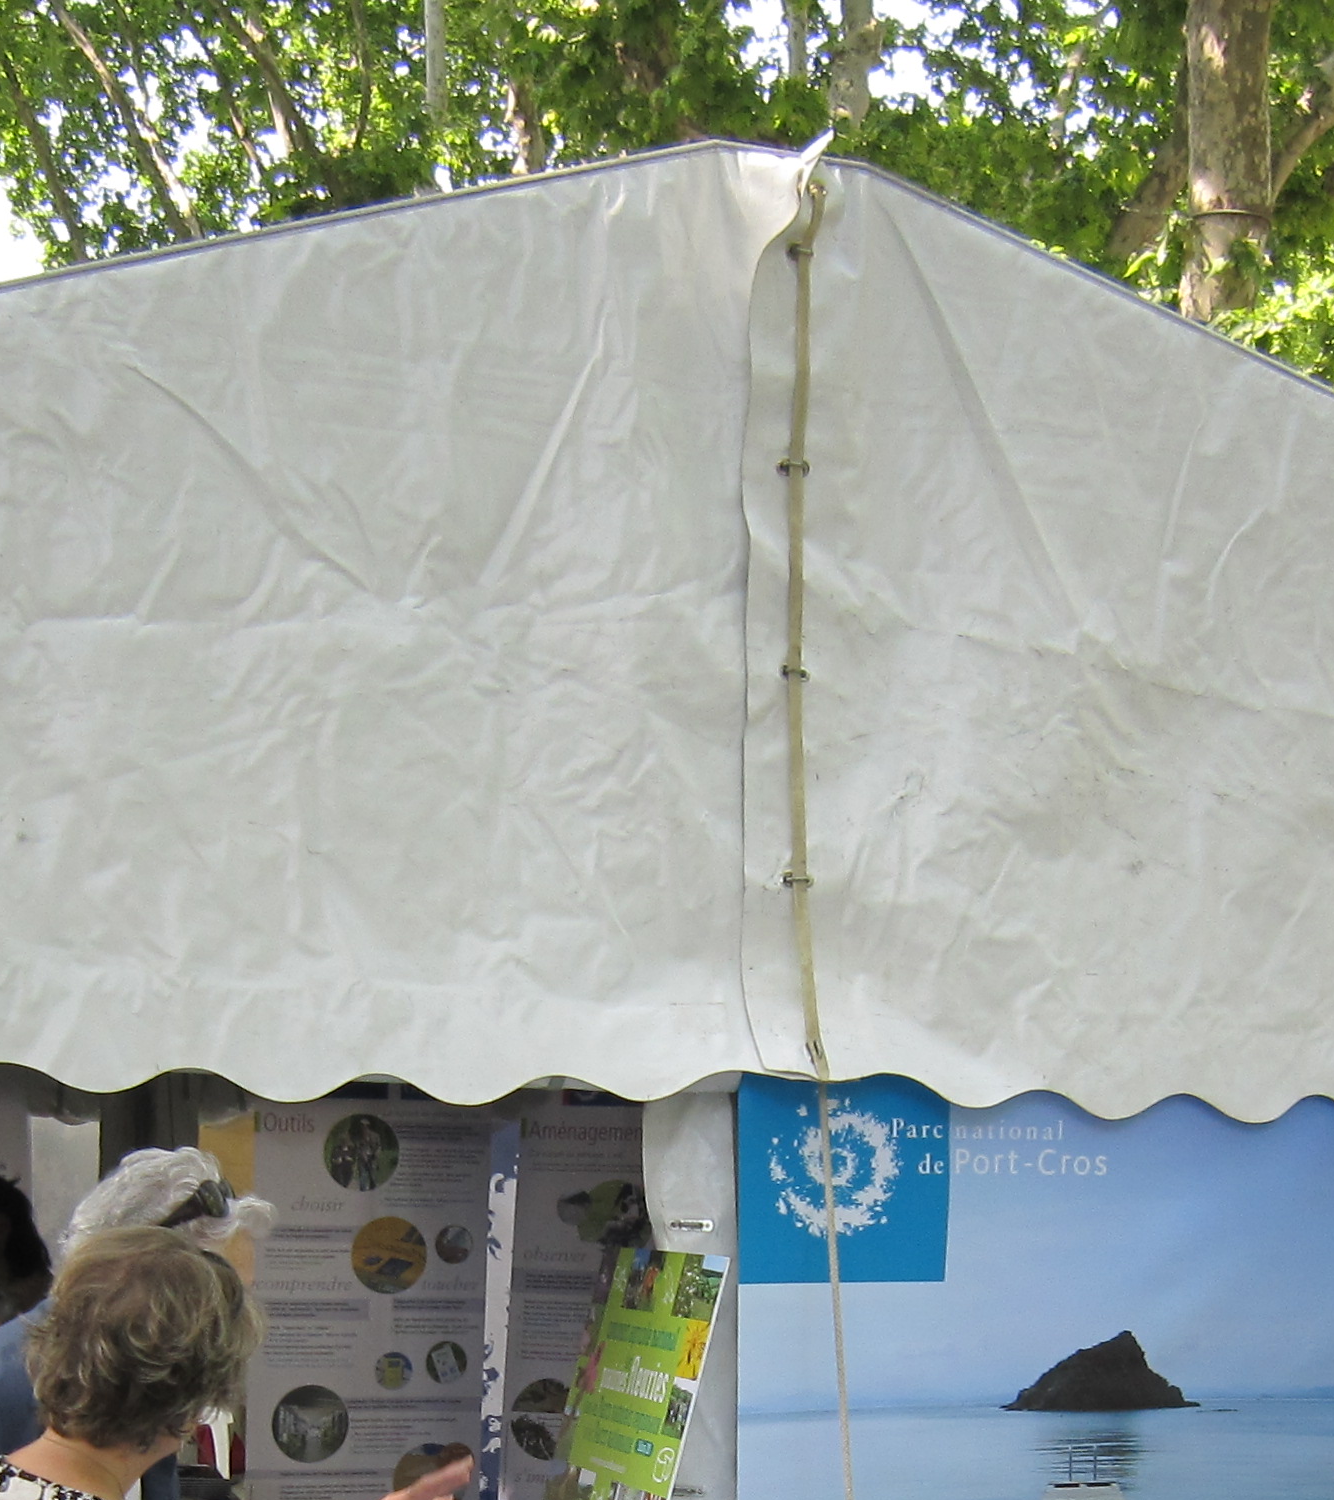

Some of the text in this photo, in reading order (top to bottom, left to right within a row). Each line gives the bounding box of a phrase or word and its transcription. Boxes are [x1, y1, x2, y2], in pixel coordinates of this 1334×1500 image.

[263, 1111, 317, 1134] Outils
[529, 1120, 644, 1146] Aménagemen
[890, 1118, 1065, 1142] Parc national
[918, 1149, 1108, 1178] de Port-Cros
